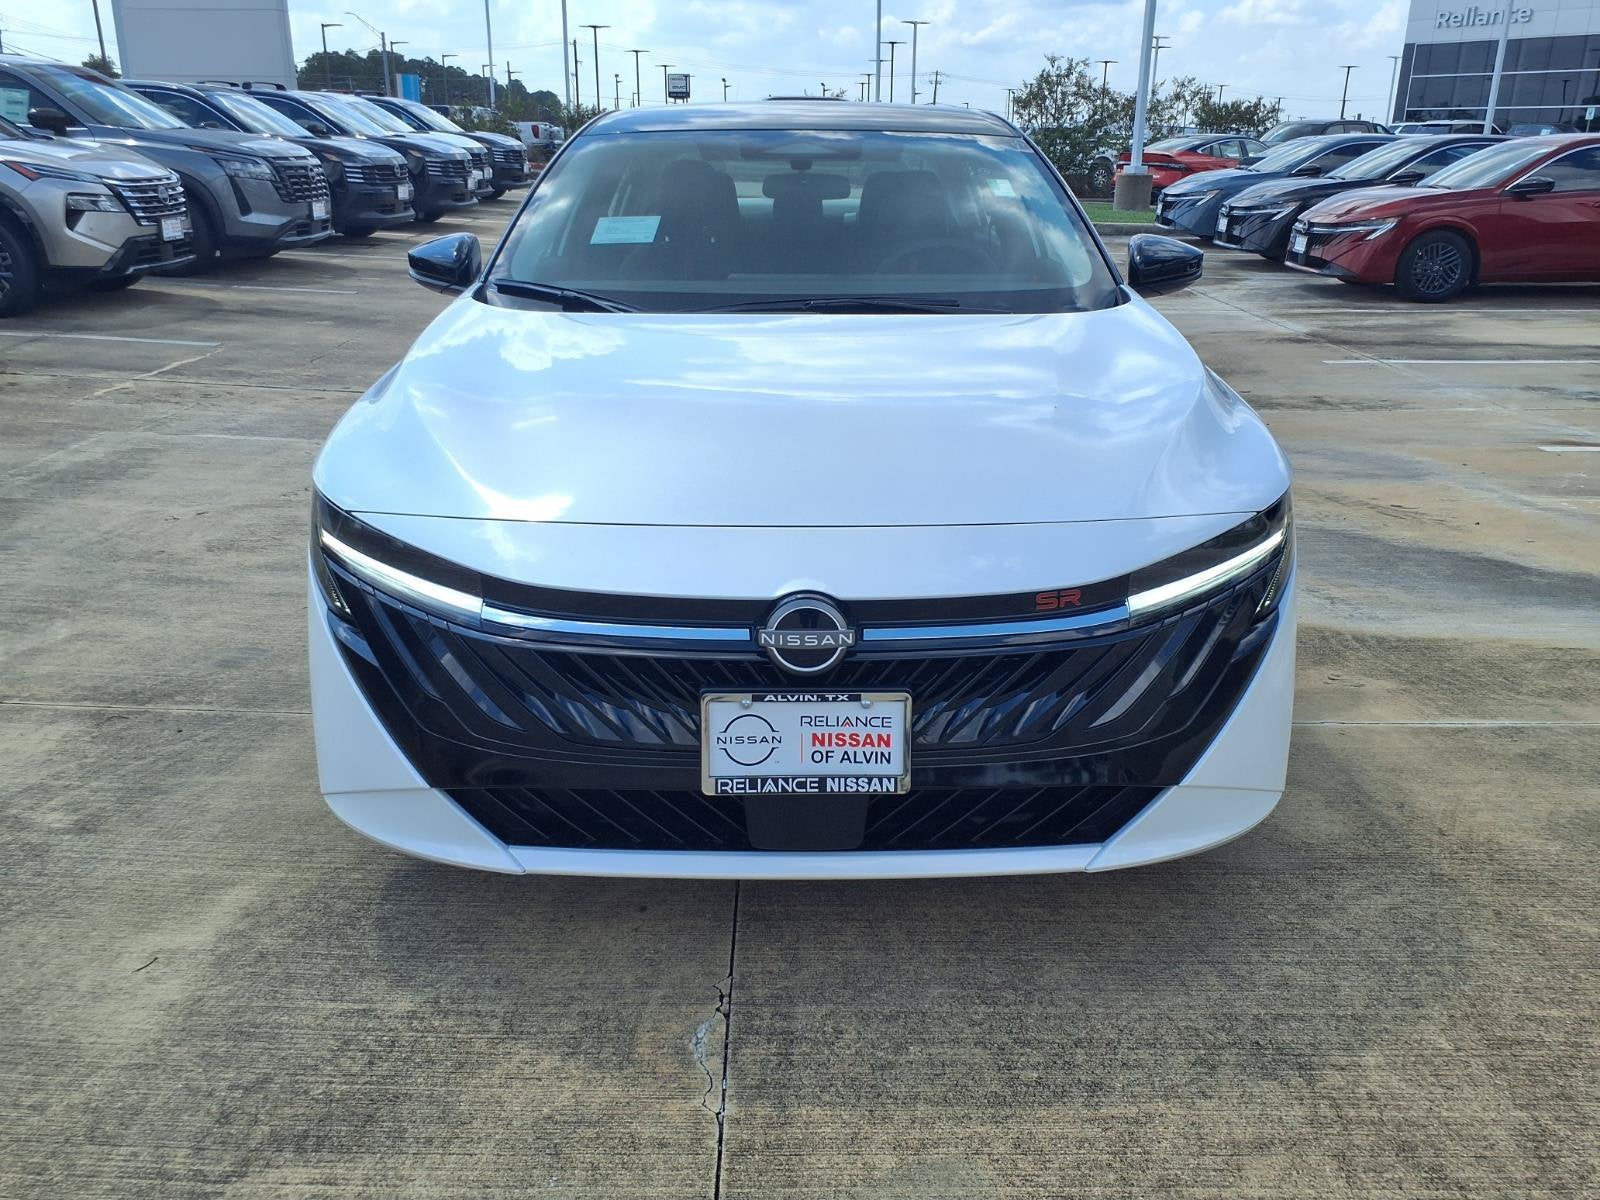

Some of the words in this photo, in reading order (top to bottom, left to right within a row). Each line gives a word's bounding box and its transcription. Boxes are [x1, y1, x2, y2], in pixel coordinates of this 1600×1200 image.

[1036, 589, 1082, 610] SR
[761, 632, 853, 646] NISSAN
[825, 694, 849, 702] TX
[800, 715, 893, 728] RELIANCE
[716, 735, 782, 745] NISSAN
[811, 732, 892, 748] NISSAN
[811, 750, 835, 764] OF
[840, 750, 892, 765] ALVIN
[717, 778, 819, 794] RELIANCE
[826, 777, 895, 793] NISSAN
